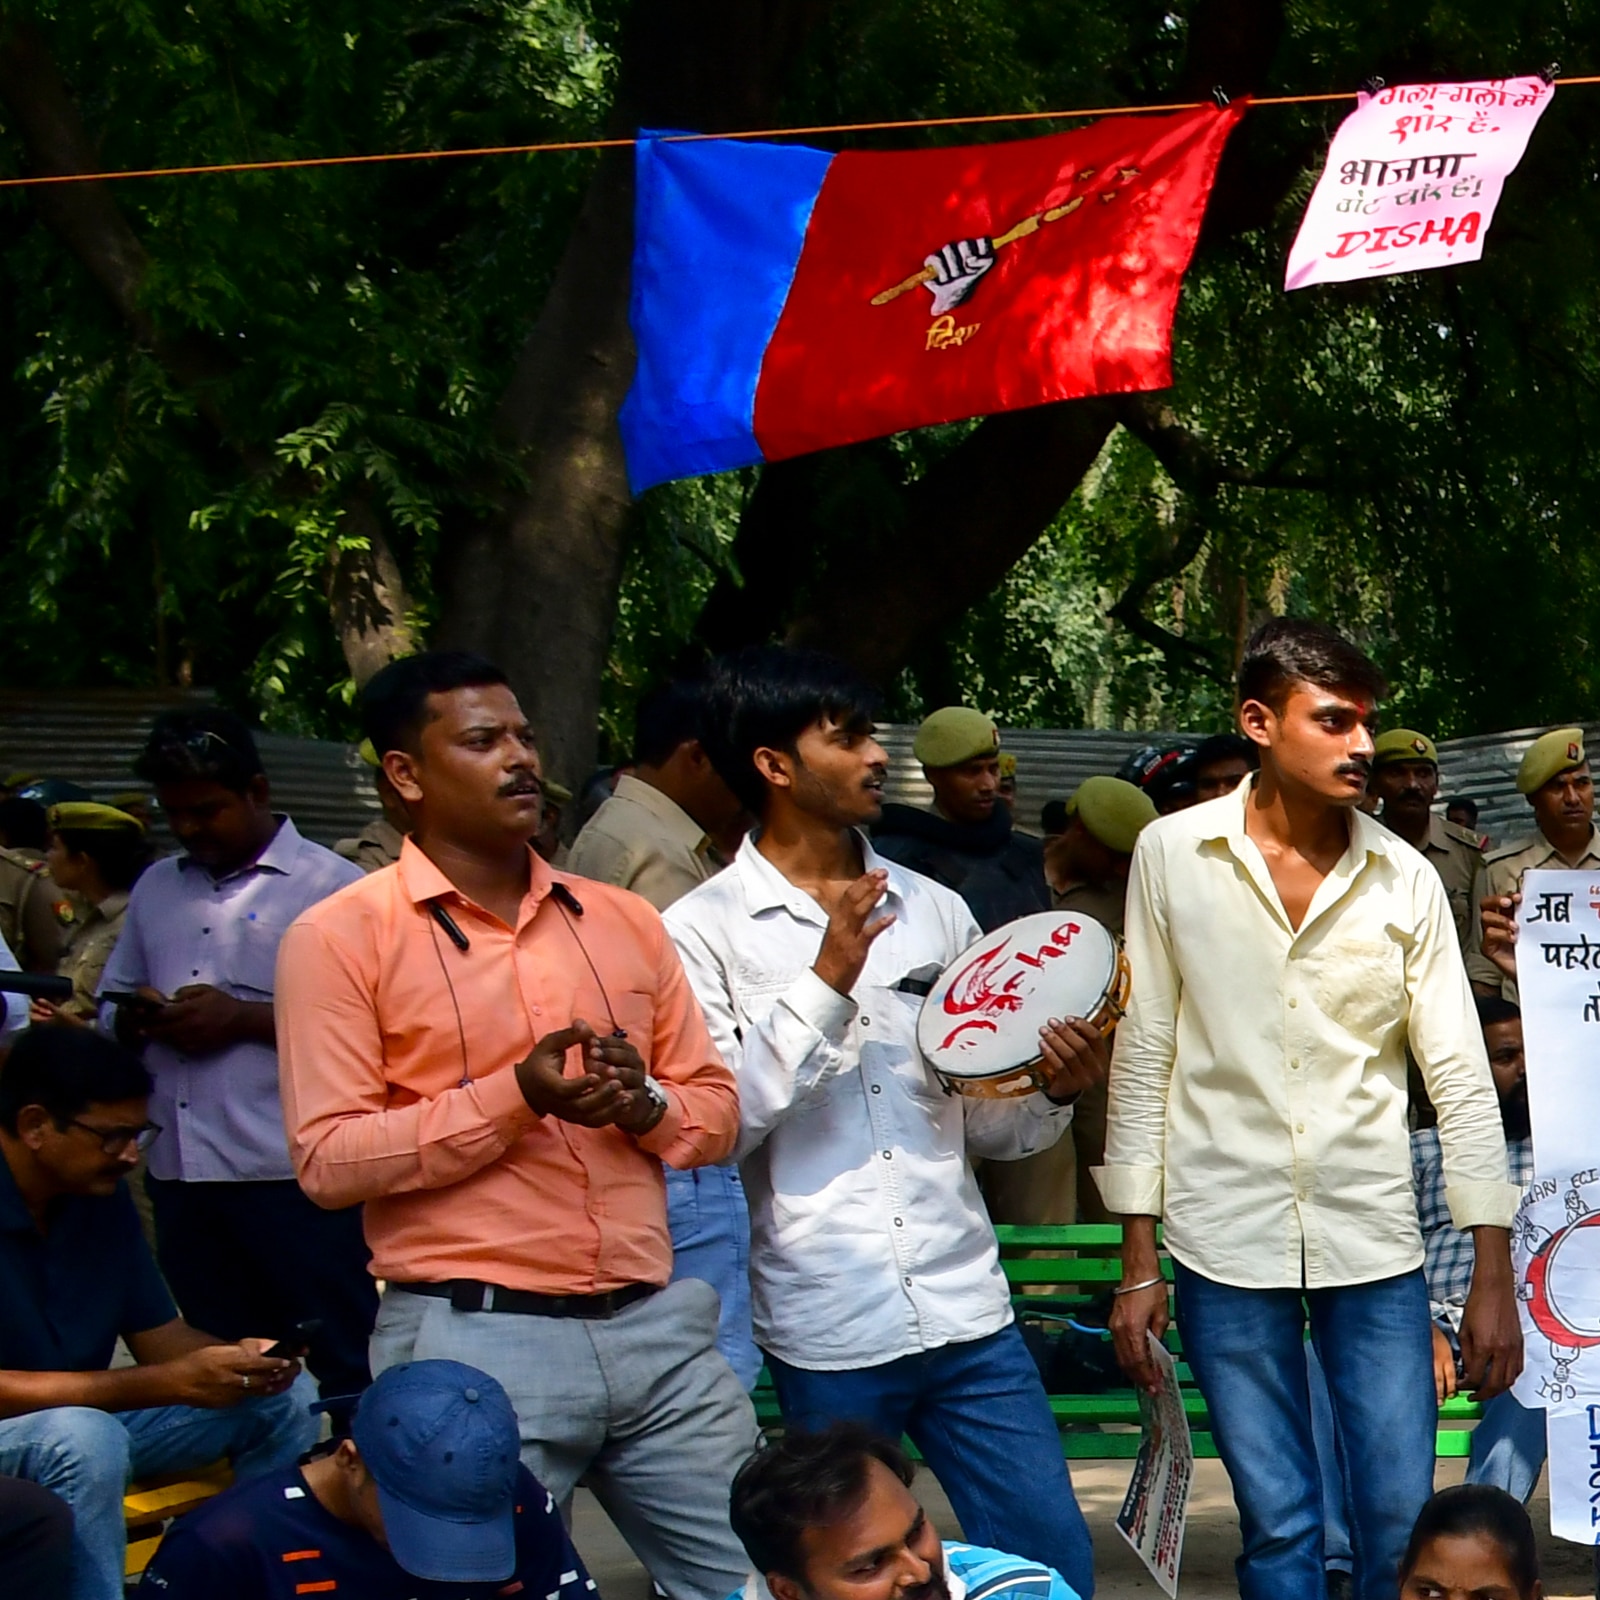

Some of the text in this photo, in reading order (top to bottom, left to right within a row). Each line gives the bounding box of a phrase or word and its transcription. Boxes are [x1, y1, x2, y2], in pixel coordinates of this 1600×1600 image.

[1341, 154, 1476, 187] भाजपा
[1326, 212, 1481, 258] DISHA
[1526, 893, 1573, 922] जब
[1571, 1169, 1598, 1188] ECI
